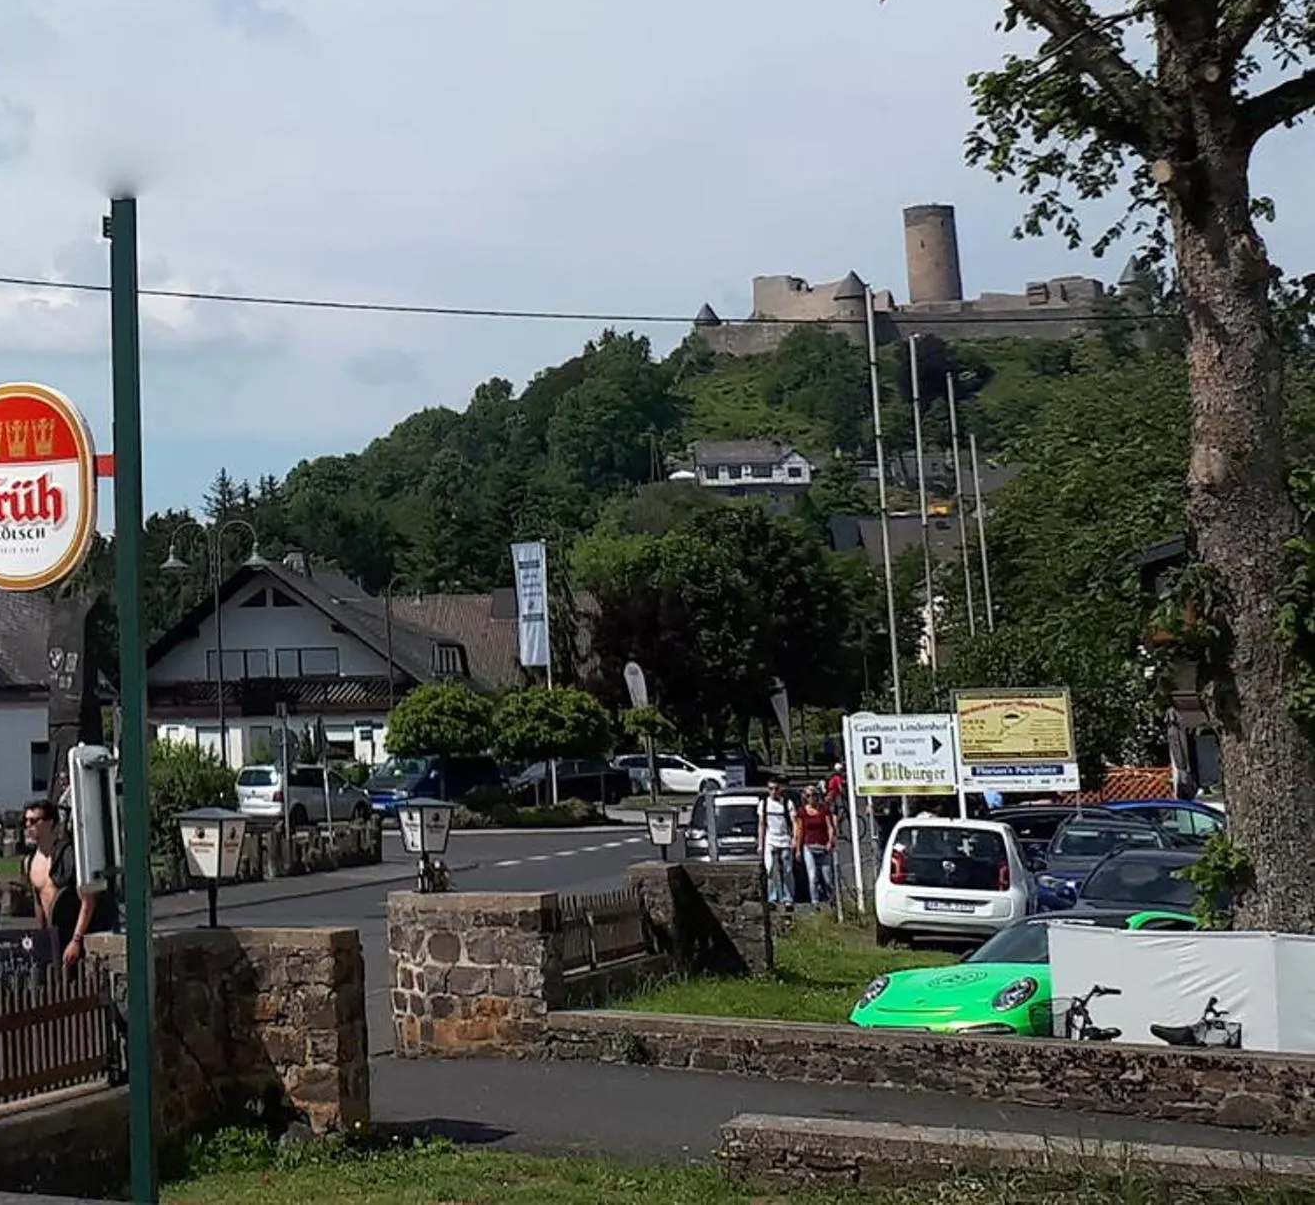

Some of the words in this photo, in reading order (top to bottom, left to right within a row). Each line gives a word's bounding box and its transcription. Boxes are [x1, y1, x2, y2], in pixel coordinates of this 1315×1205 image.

[854, 721, 898, 732] Gasthaus
[900, 720, 948, 731] Lindenhof
[881, 761, 947, 783] Bitburger
